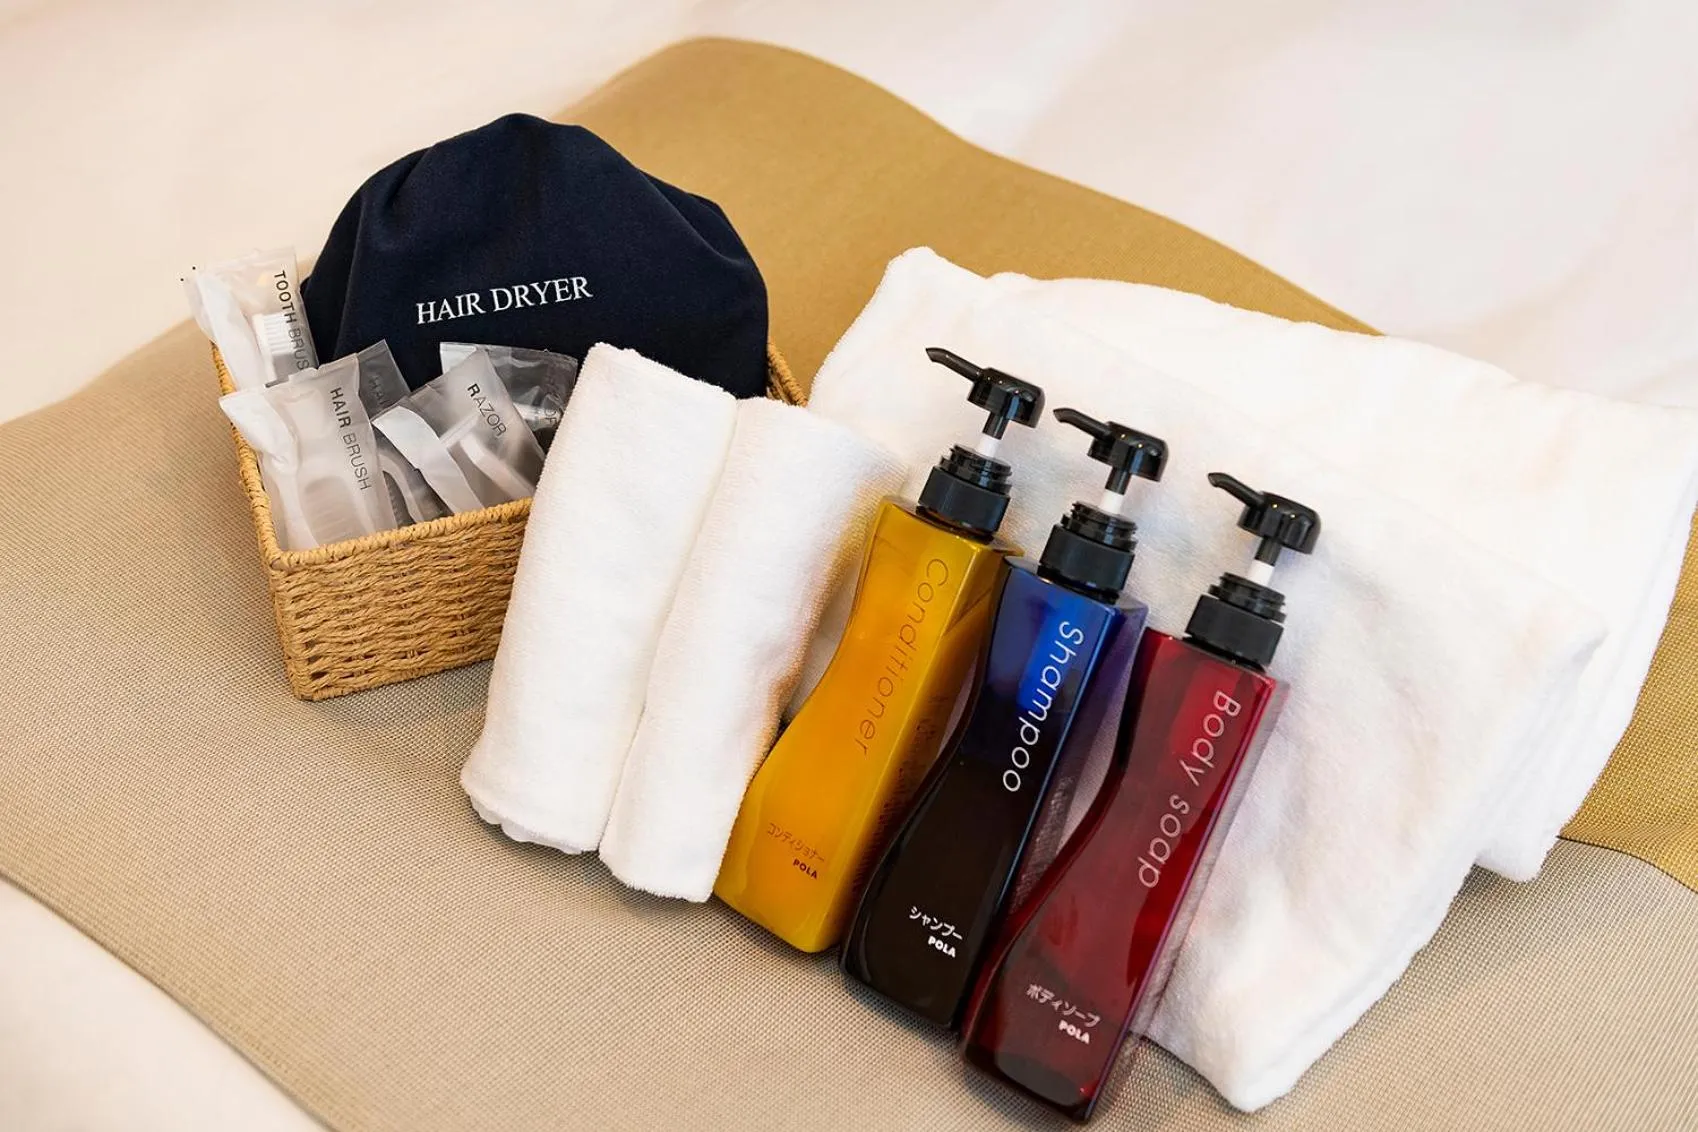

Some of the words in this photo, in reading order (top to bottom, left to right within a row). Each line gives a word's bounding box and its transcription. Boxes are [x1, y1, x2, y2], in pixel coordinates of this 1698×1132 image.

[274, 270, 297, 324] TOOTH
[288, 327, 310, 370] BRUS
[416, 292, 486, 325] HAIR
[490, 276, 594, 312] DRYER
[330, 386, 351, 429] HAIR
[343, 432, 371, 491] BRUSH
[467, 382, 507, 437] RAZOR
[855, 558, 949, 757] Conditioner
[1002, 621, 1084, 792] Shampoo
[1179, 690, 1241, 787] Body
[793, 858, 818, 879] POLA
[1138, 794, 1190, 888] soap
[909, 906, 963, 941] シャンプー
[928, 936, 956, 958] POLA
[1059, 1020, 1090, 1044] POLA
